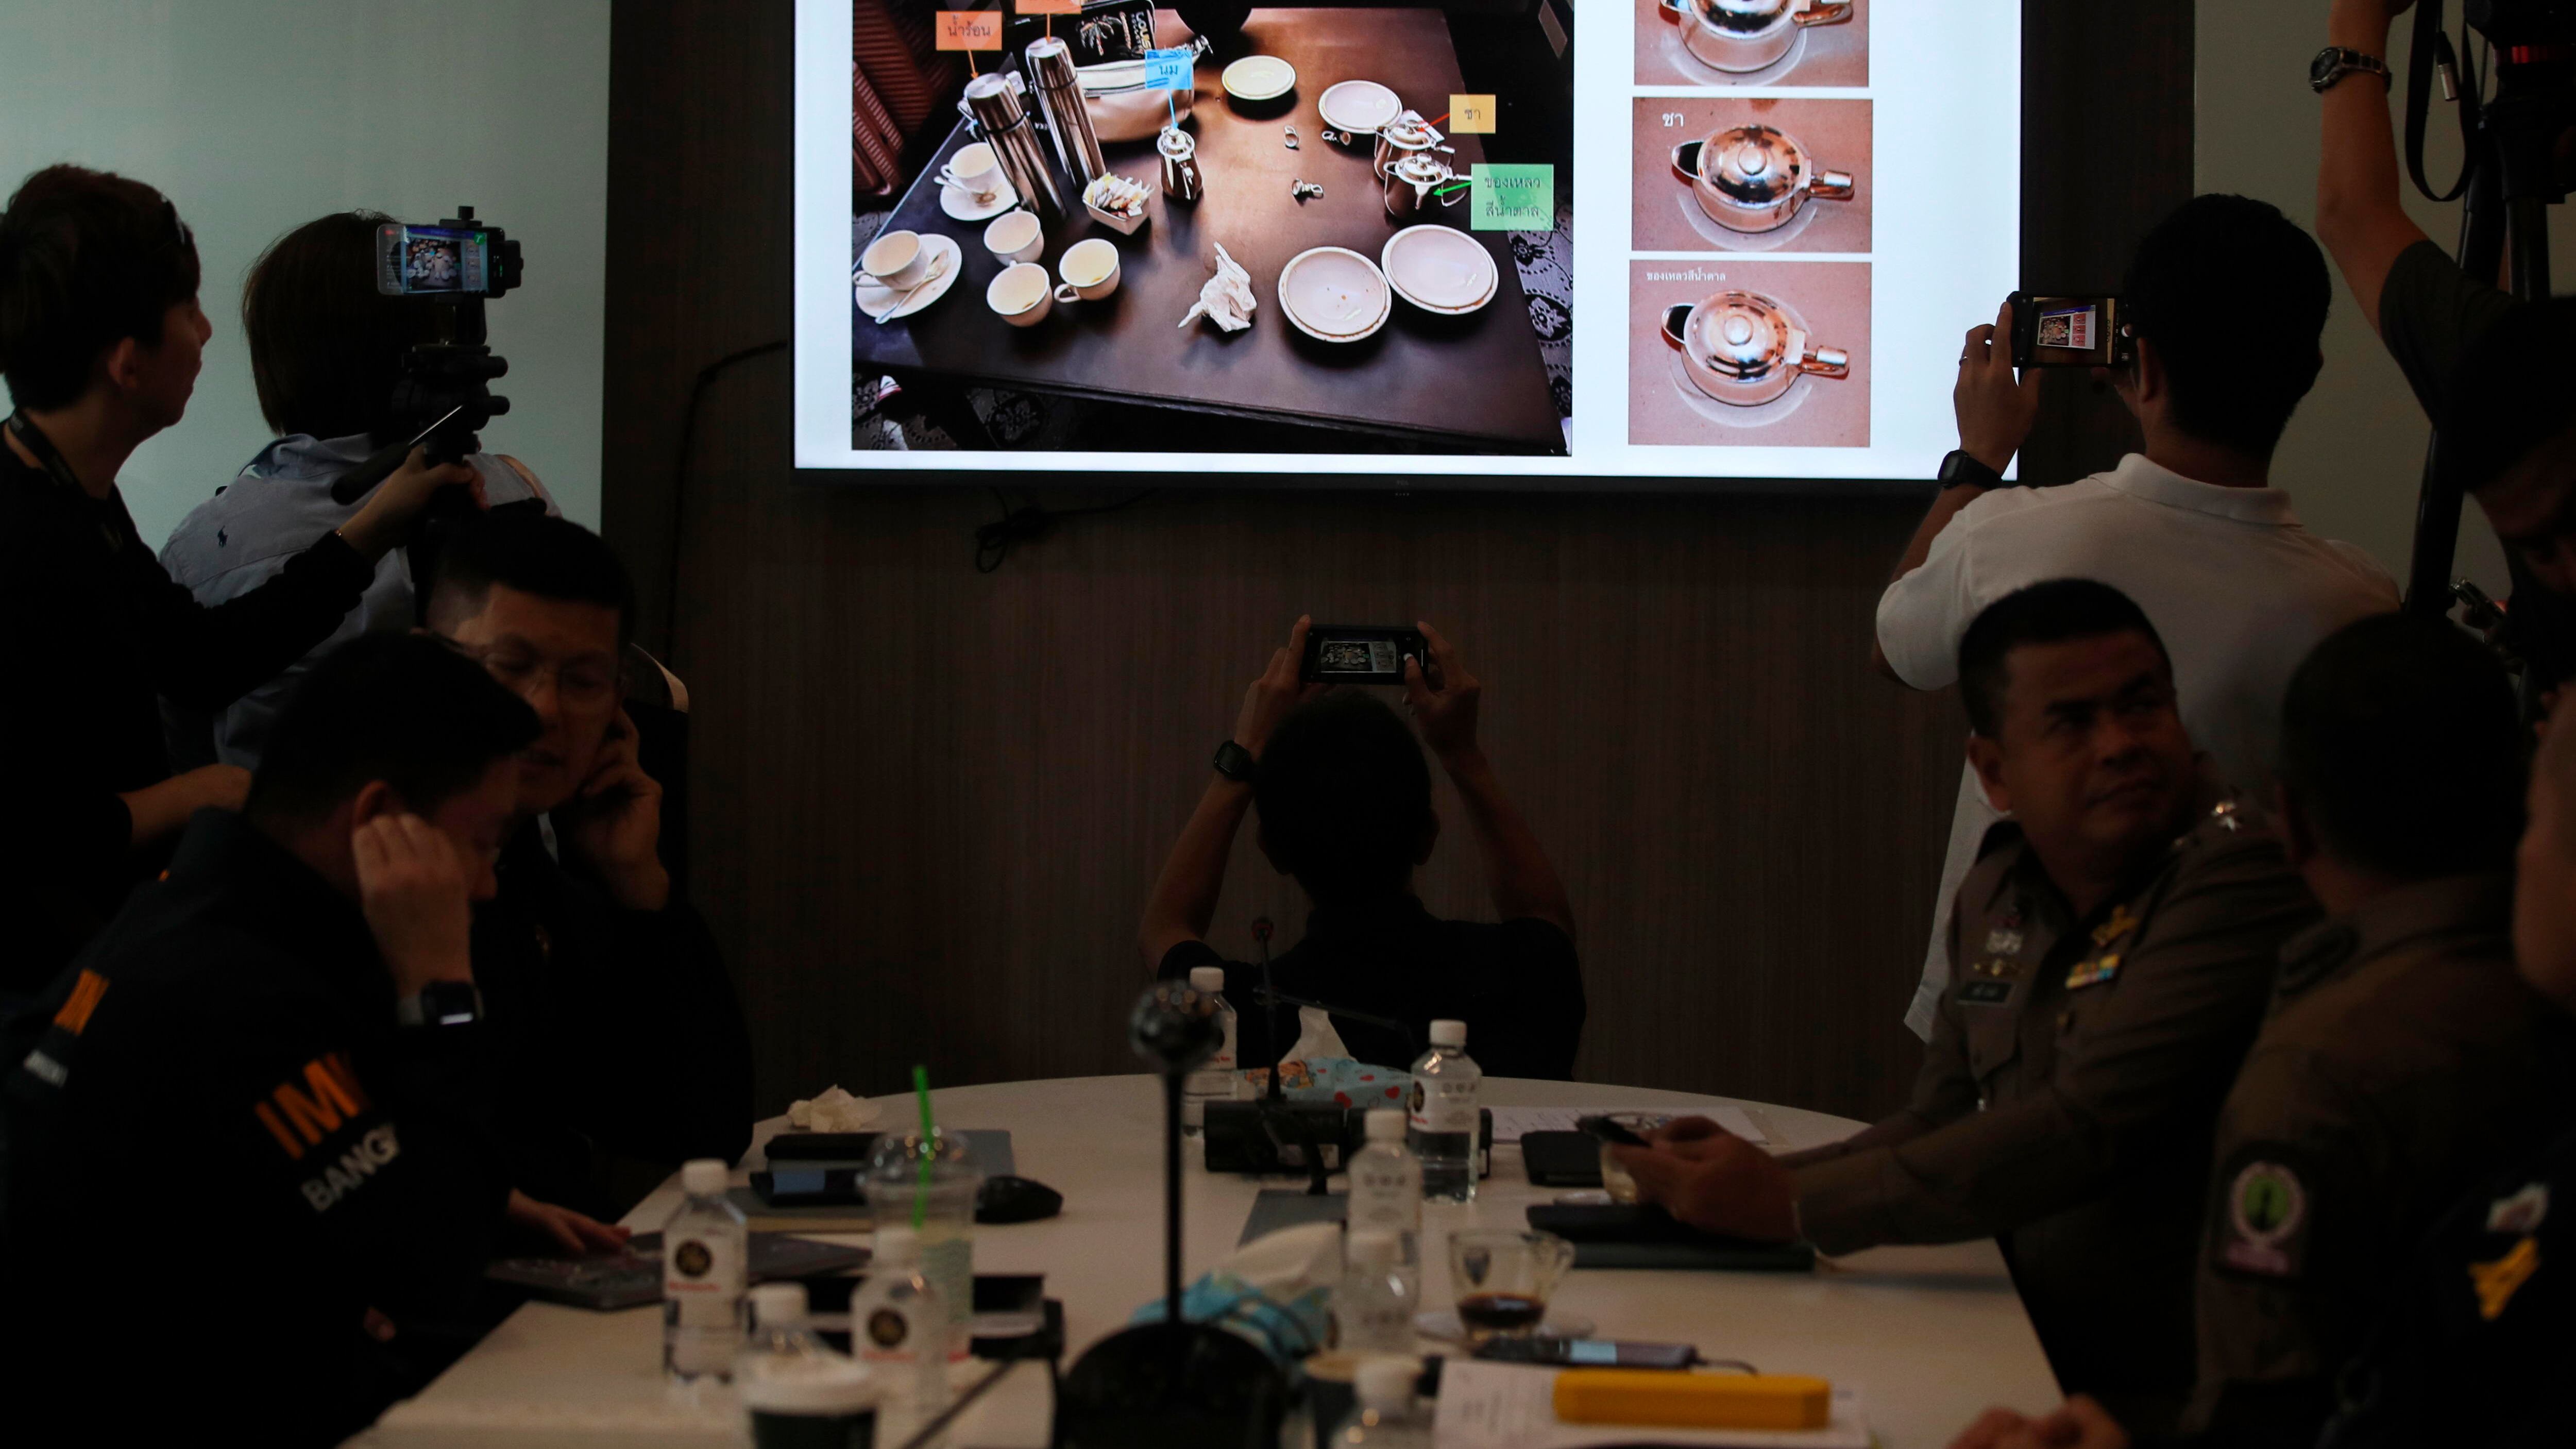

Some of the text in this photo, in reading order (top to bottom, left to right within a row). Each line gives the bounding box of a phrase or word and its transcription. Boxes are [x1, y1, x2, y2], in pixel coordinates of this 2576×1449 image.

[947, 14, 991, 36] น้ำร้อน
[1159, 65, 1178, 75] นม
[1662, 112, 1684, 127] ชา
[1484, 177, 1540, 188] ของเหลว
[1486, 195, 1539, 217] สีน้ำตาล
[1646, 266, 1726, 281] ของเหลวสีน้ำตาล
[299, 1121, 401, 1213] BANG
